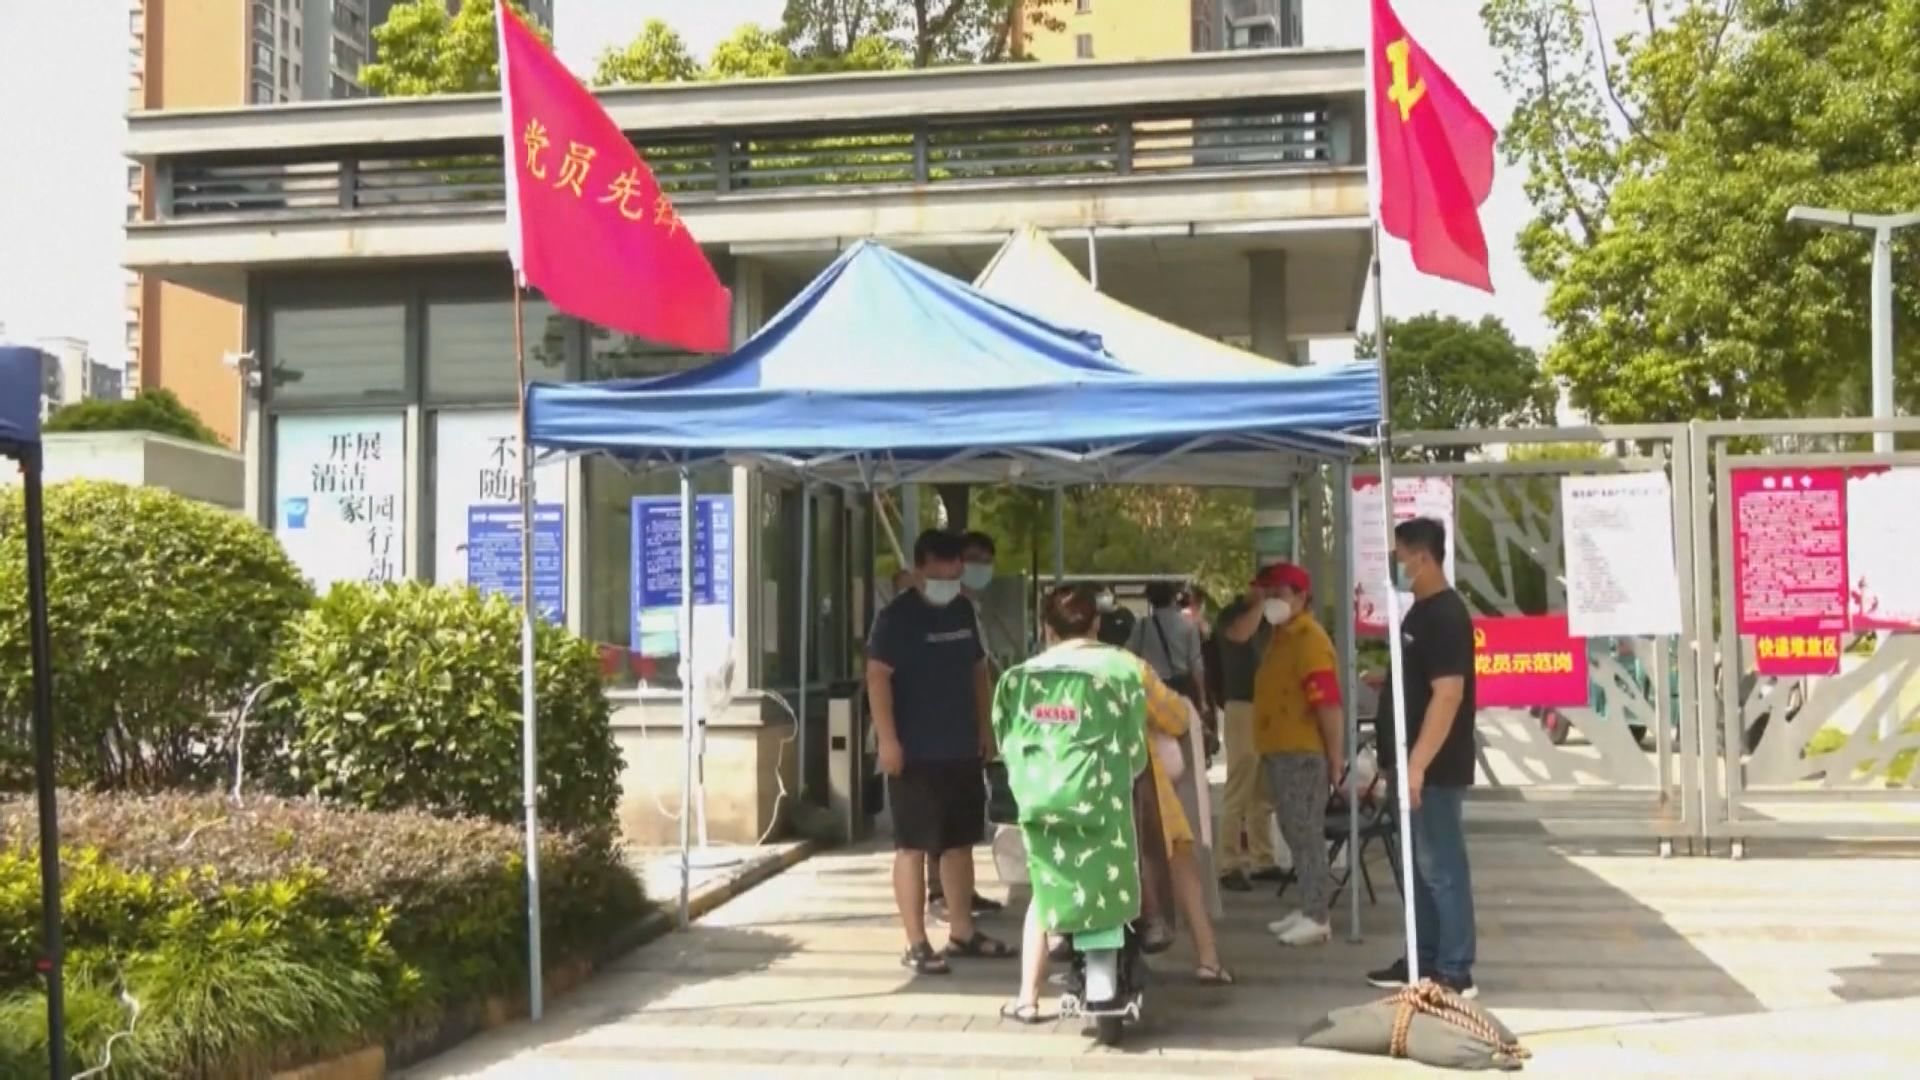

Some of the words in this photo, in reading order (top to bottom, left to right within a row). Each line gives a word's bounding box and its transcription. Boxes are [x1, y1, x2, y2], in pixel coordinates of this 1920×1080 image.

[328, 431, 381, 461] 开展
[487, 434, 516, 468] 不
[311, 463, 365, 493] 清洁
